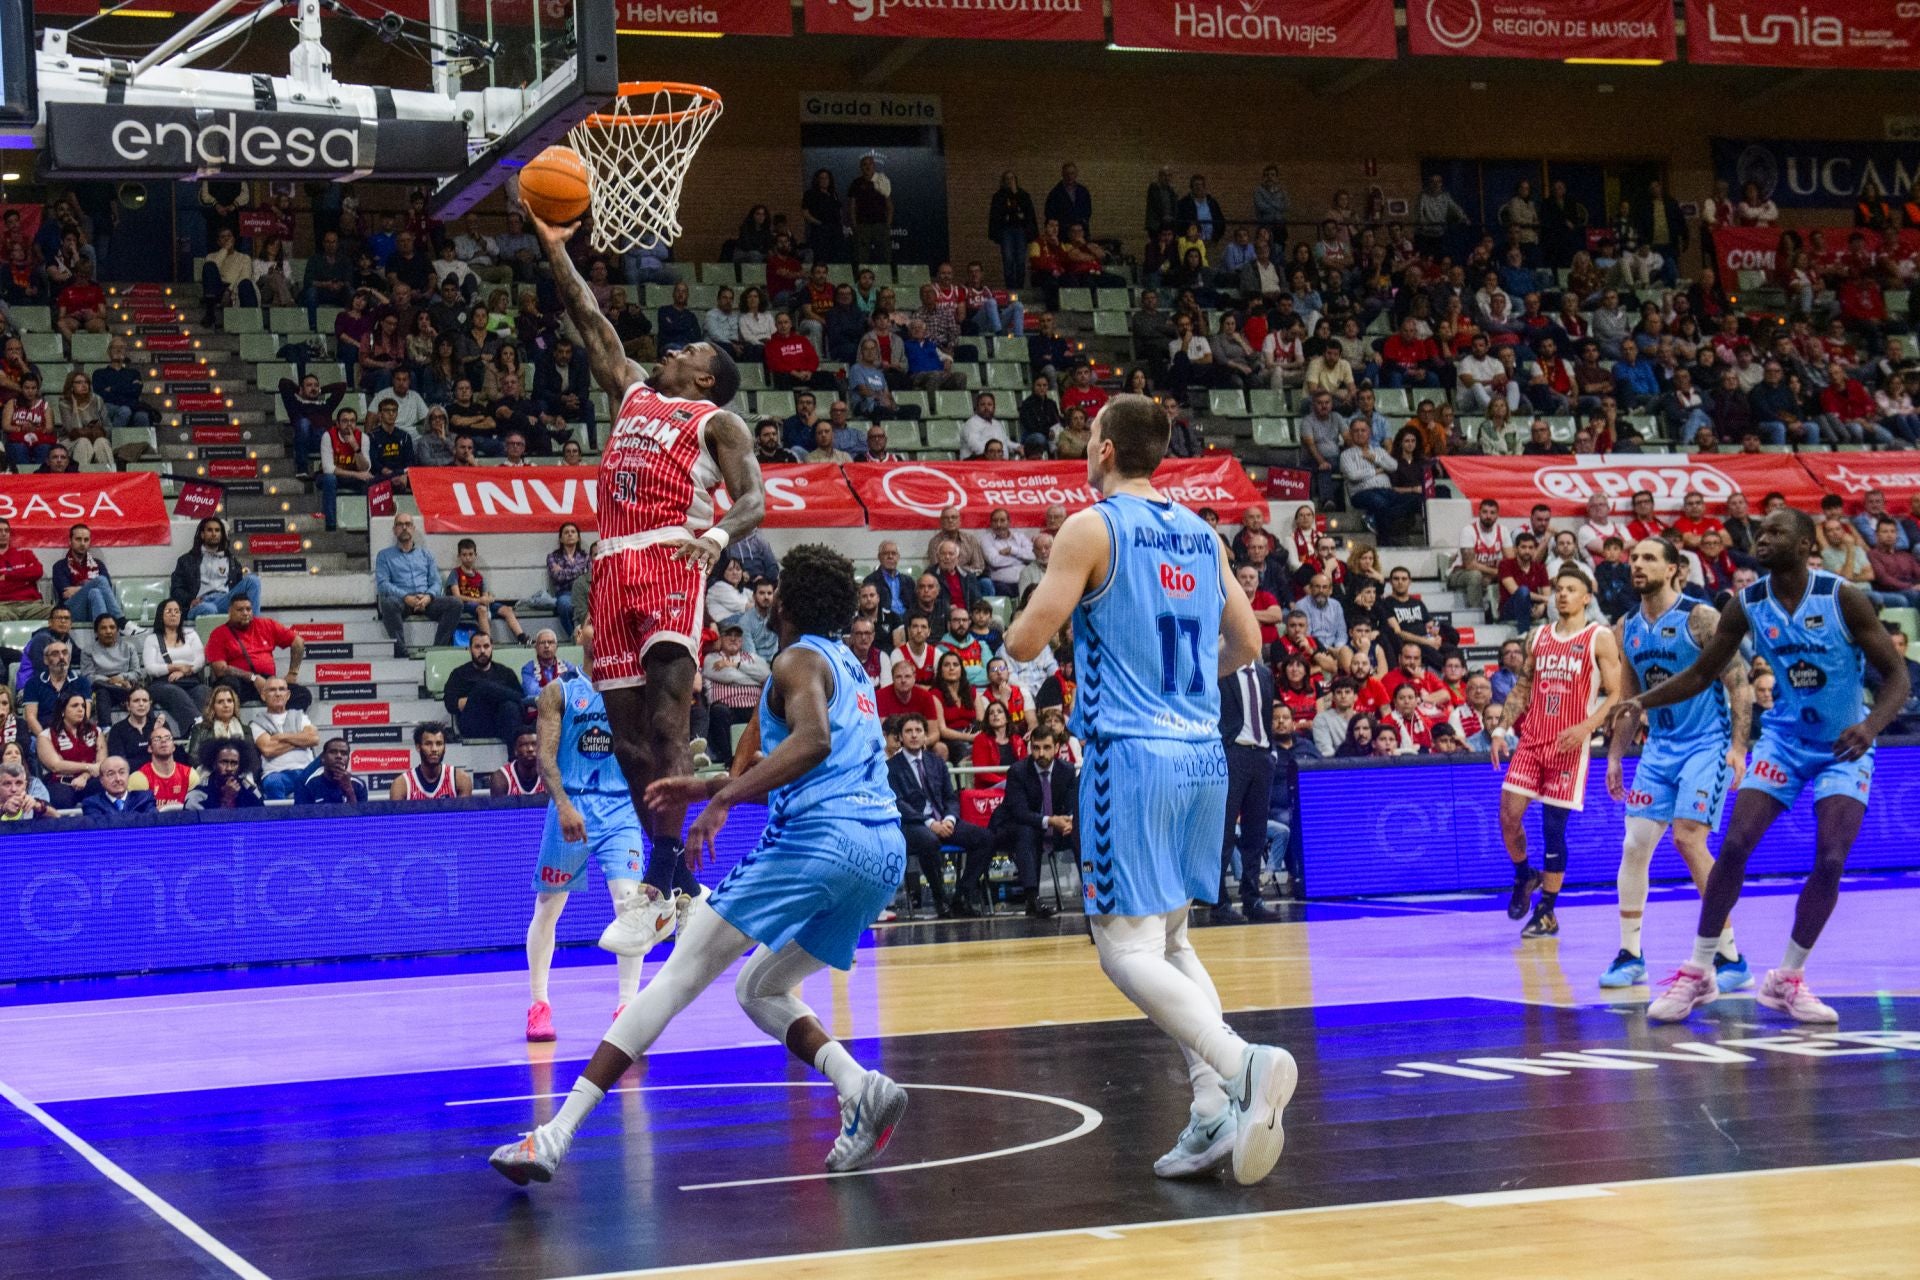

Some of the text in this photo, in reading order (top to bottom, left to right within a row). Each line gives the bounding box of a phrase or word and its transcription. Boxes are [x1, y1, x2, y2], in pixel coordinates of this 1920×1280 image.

[627, 4, 718, 24] Helvetia
[1492, 17, 1657, 38] REGIÓN DE MURCIA
[806, 98, 936, 118] Grada Norte
[112, 112, 359, 167] endesa
[612, 415, 681, 452] UCAM
[614, 471, 638, 504] 31
[978, 474, 1058, 489] Costa Cálida
[1273, 478, 1305, 489] MÓDULO
[184, 494, 215, 507] MÓDULO
[983, 486, 1087, 505] REGIÓN
[1157, 613, 1205, 695] 17
[1536, 654, 1583, 675] UCAM
[1541, 671, 1573, 682] MURCIA
[1546, 694, 1561, 714] 12
[582, 734, 611, 745] Estrella
[582, 743, 609, 752] Galicia
[18, 836, 459, 942] endesa
